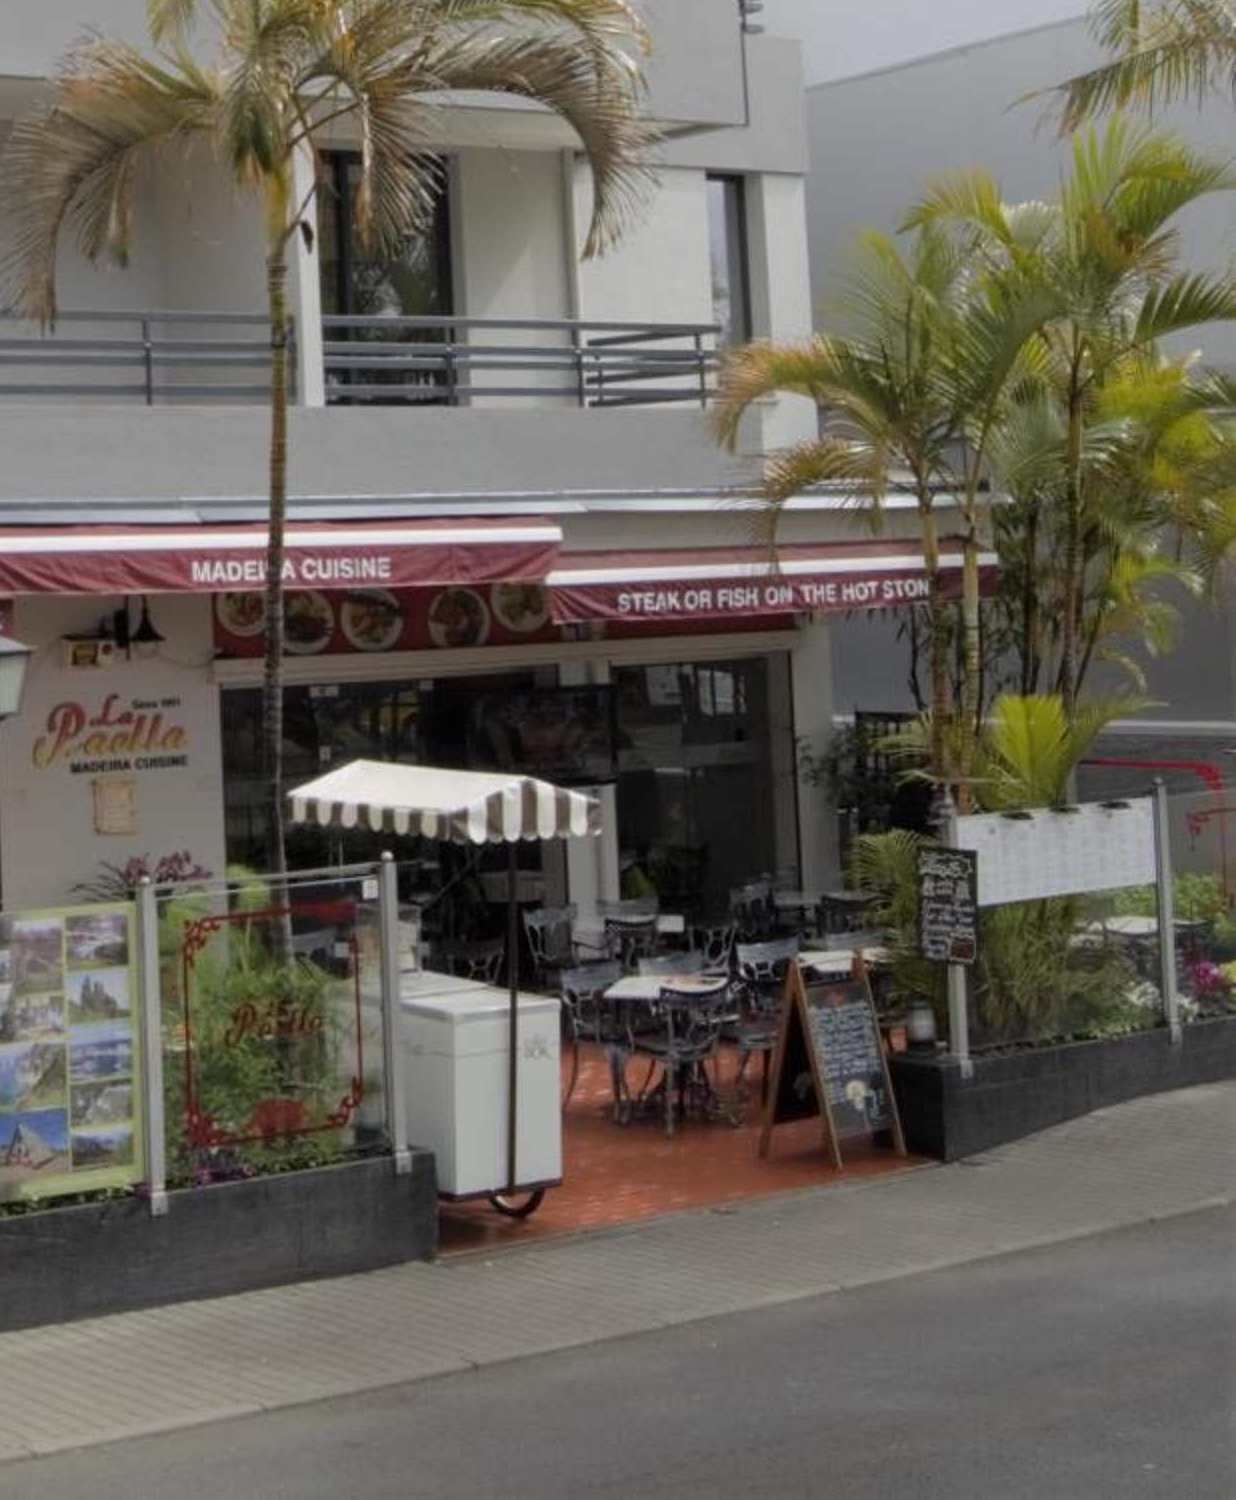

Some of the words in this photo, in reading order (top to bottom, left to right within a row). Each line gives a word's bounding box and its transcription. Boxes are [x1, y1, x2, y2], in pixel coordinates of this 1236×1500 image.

[191, 559, 296, 581] MADEIA
[301, 557, 392, 580] CUISINE
[617, 591, 681, 613] STEAK
[683, 589, 711, 610] OR
[717, 586, 759, 609] FISH
[764, 584, 793, 606] ON
[800, 582, 837, 604] THE
[842, 580, 879, 602] HOT
[882, 579, 931, 600] STON
[32, 700, 188, 770] Paella
